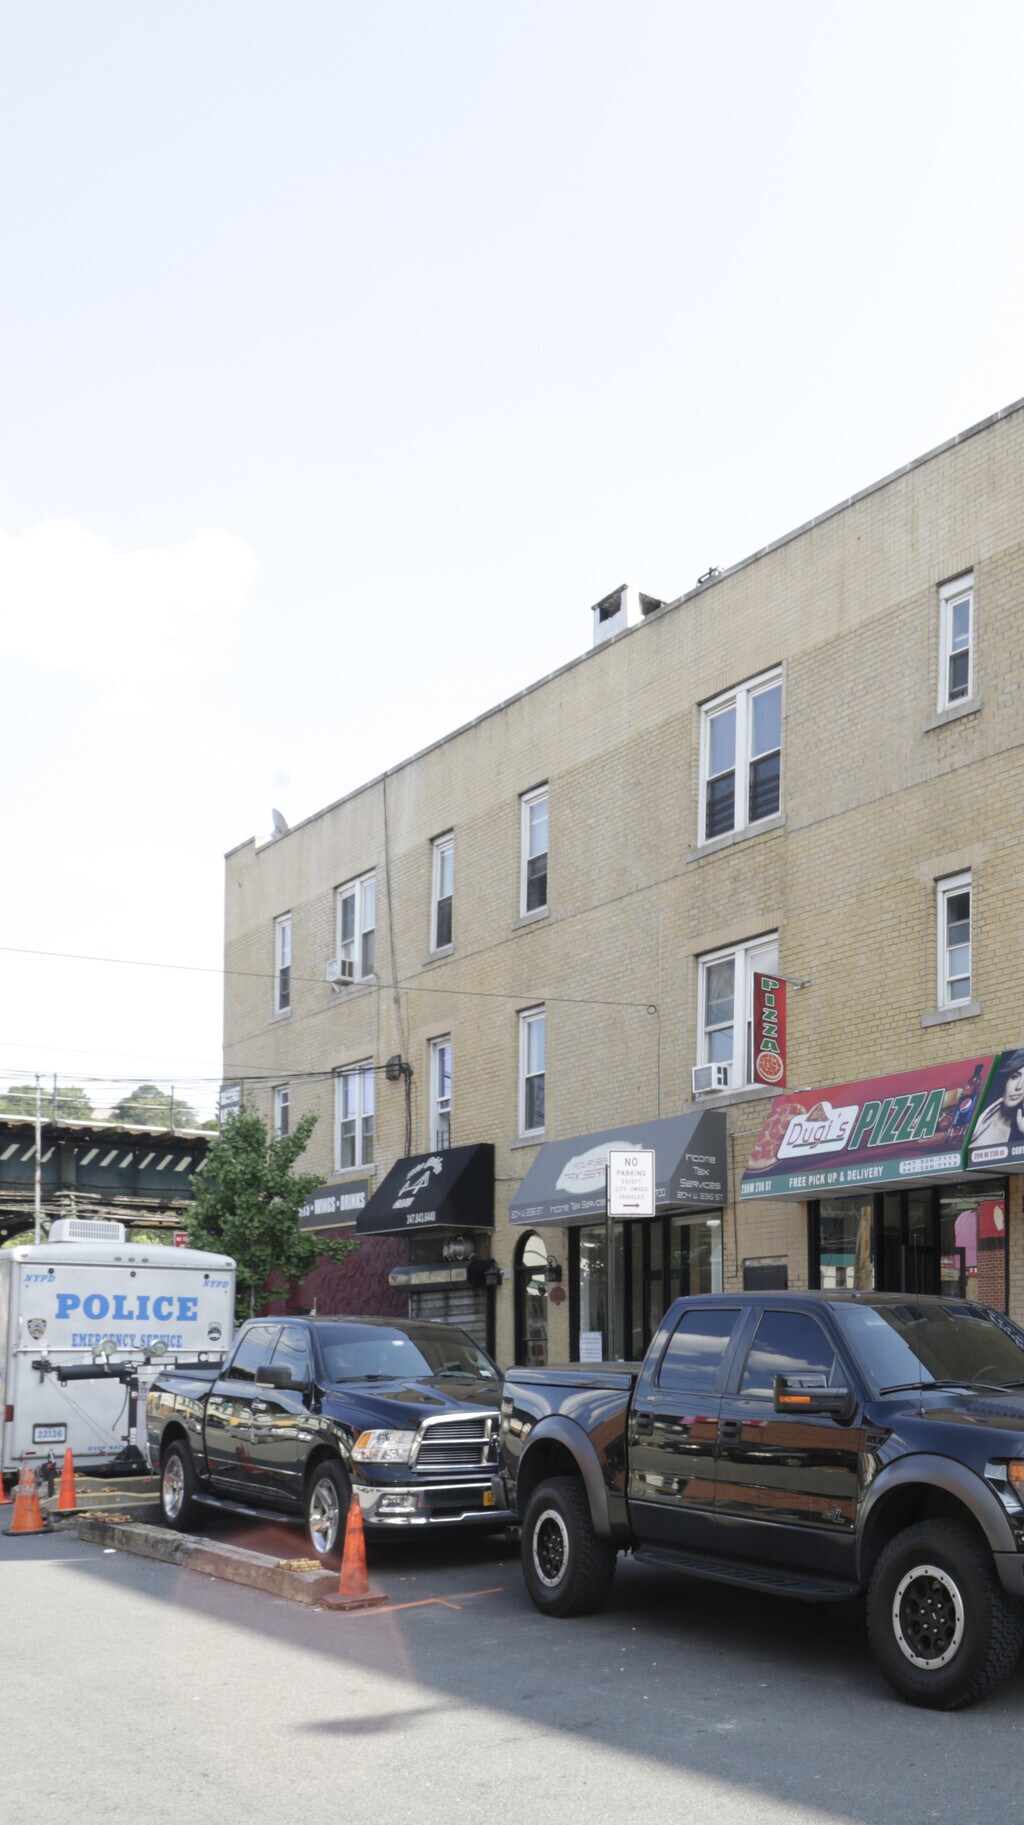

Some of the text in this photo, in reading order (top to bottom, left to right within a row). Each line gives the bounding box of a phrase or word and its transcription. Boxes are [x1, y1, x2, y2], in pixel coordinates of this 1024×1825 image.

[760, 977, 780, 1053] PIZZA
[787, 1088, 946, 1150] Dugi's PIZZA
[624, 1157, 638, 1167] NO
[616, 1169, 647, 1177] PARKING
[789, 1166, 884, 1188] FREE PICK UP & DELIVERY
[679, 1178, 722, 1190] Services
[314, 1197, 335, 1215] WINGS
[340, 1192, 365, 1211] DRINKS
[581, 1199, 607, 1209] Service
[24, 1274, 56, 1283] NYPD
[202, 1280, 229, 1288] NYPD
[55, 1293, 198, 1322] POLICE
[37, 1429, 63, 1439] 22126
